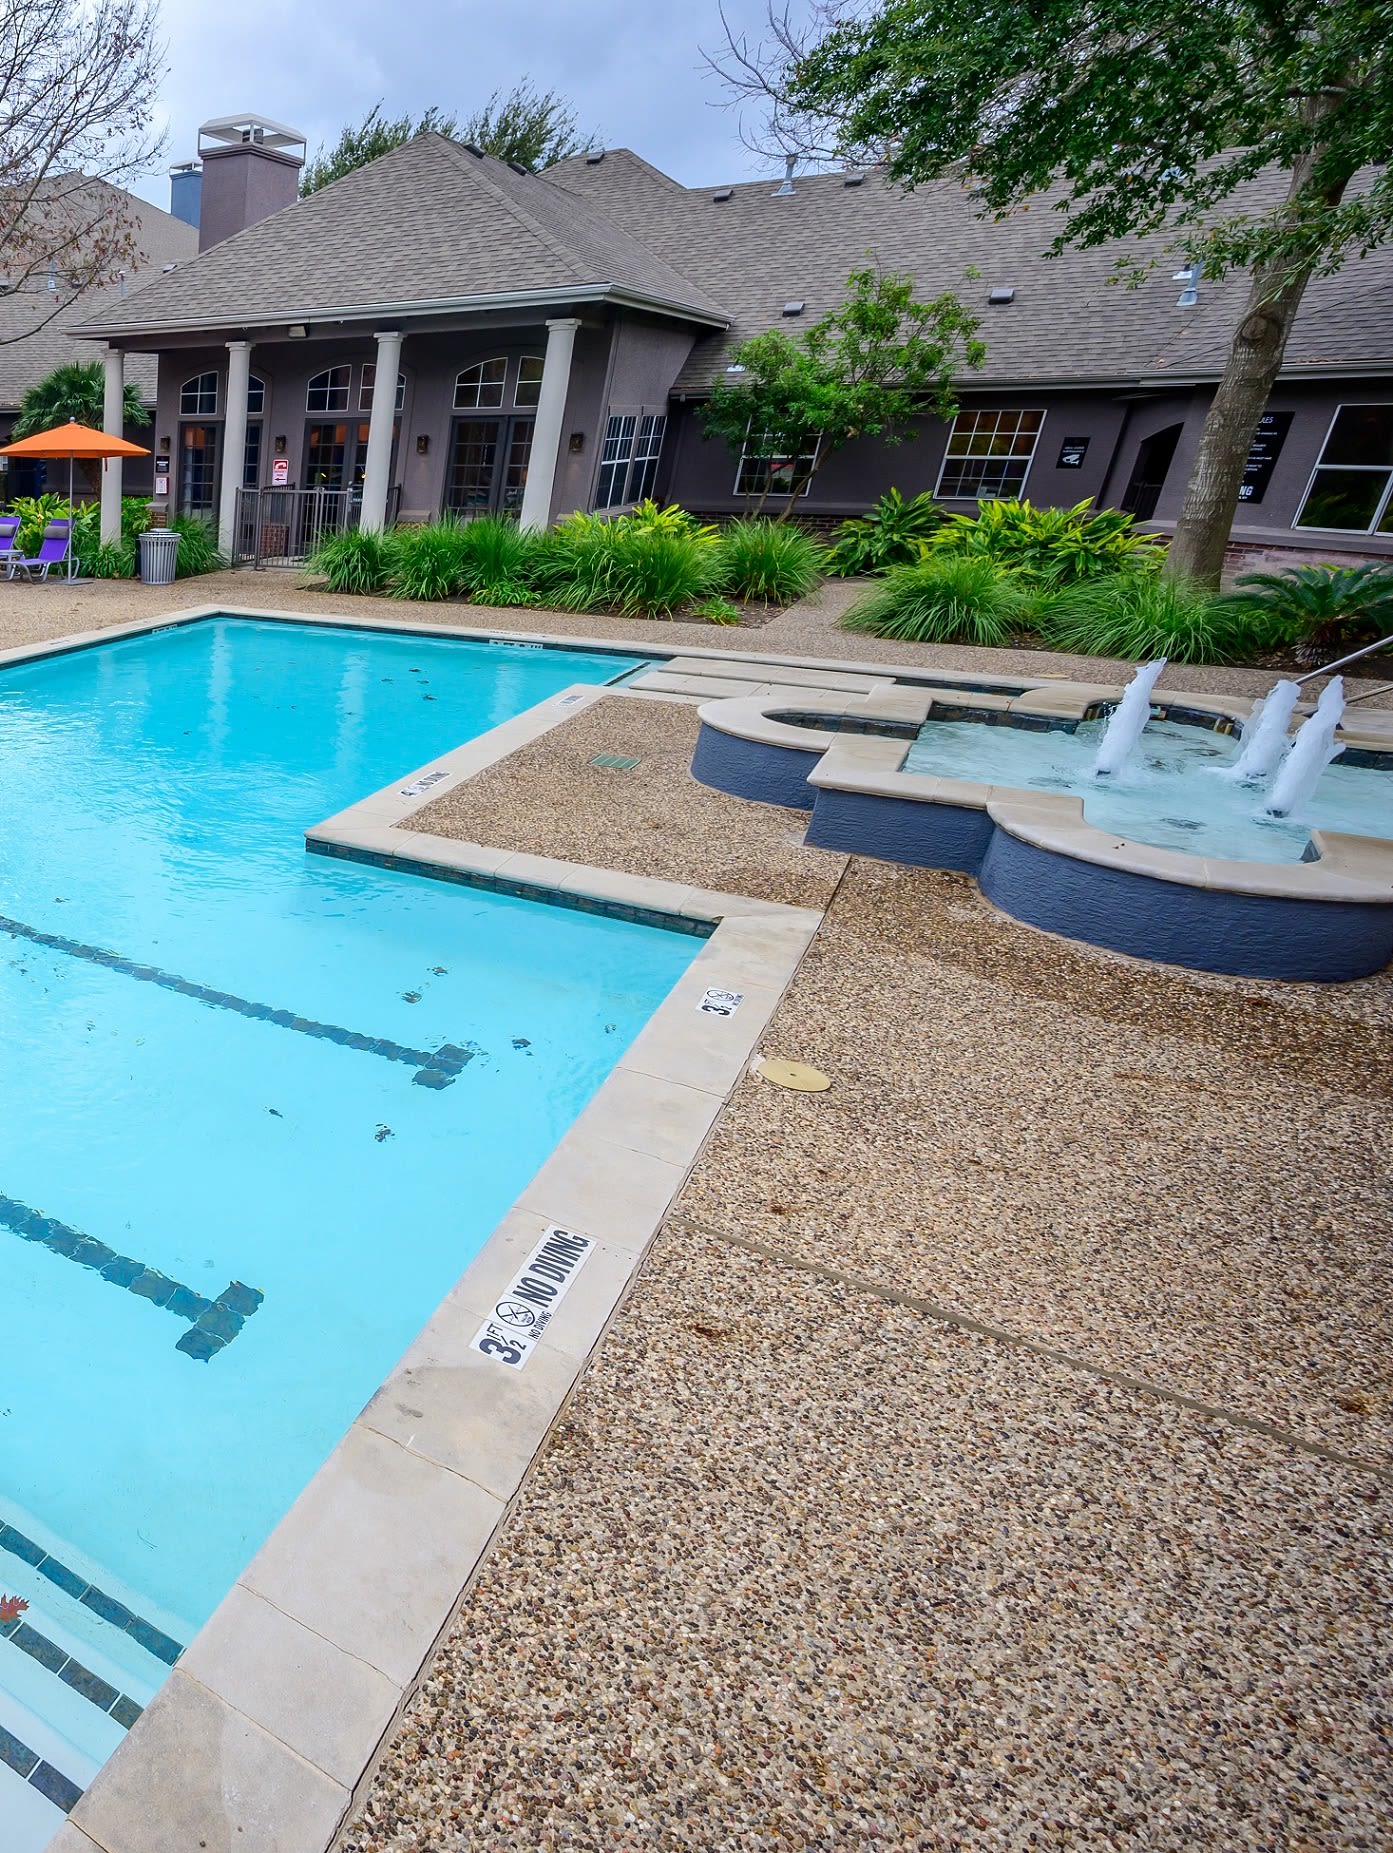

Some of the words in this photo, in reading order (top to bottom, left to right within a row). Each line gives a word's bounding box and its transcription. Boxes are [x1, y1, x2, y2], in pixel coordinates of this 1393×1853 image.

[528, 1229, 591, 1284] DIVING
[512, 1276, 558, 1309] NO
[527, 1328, 542, 1340] NO
